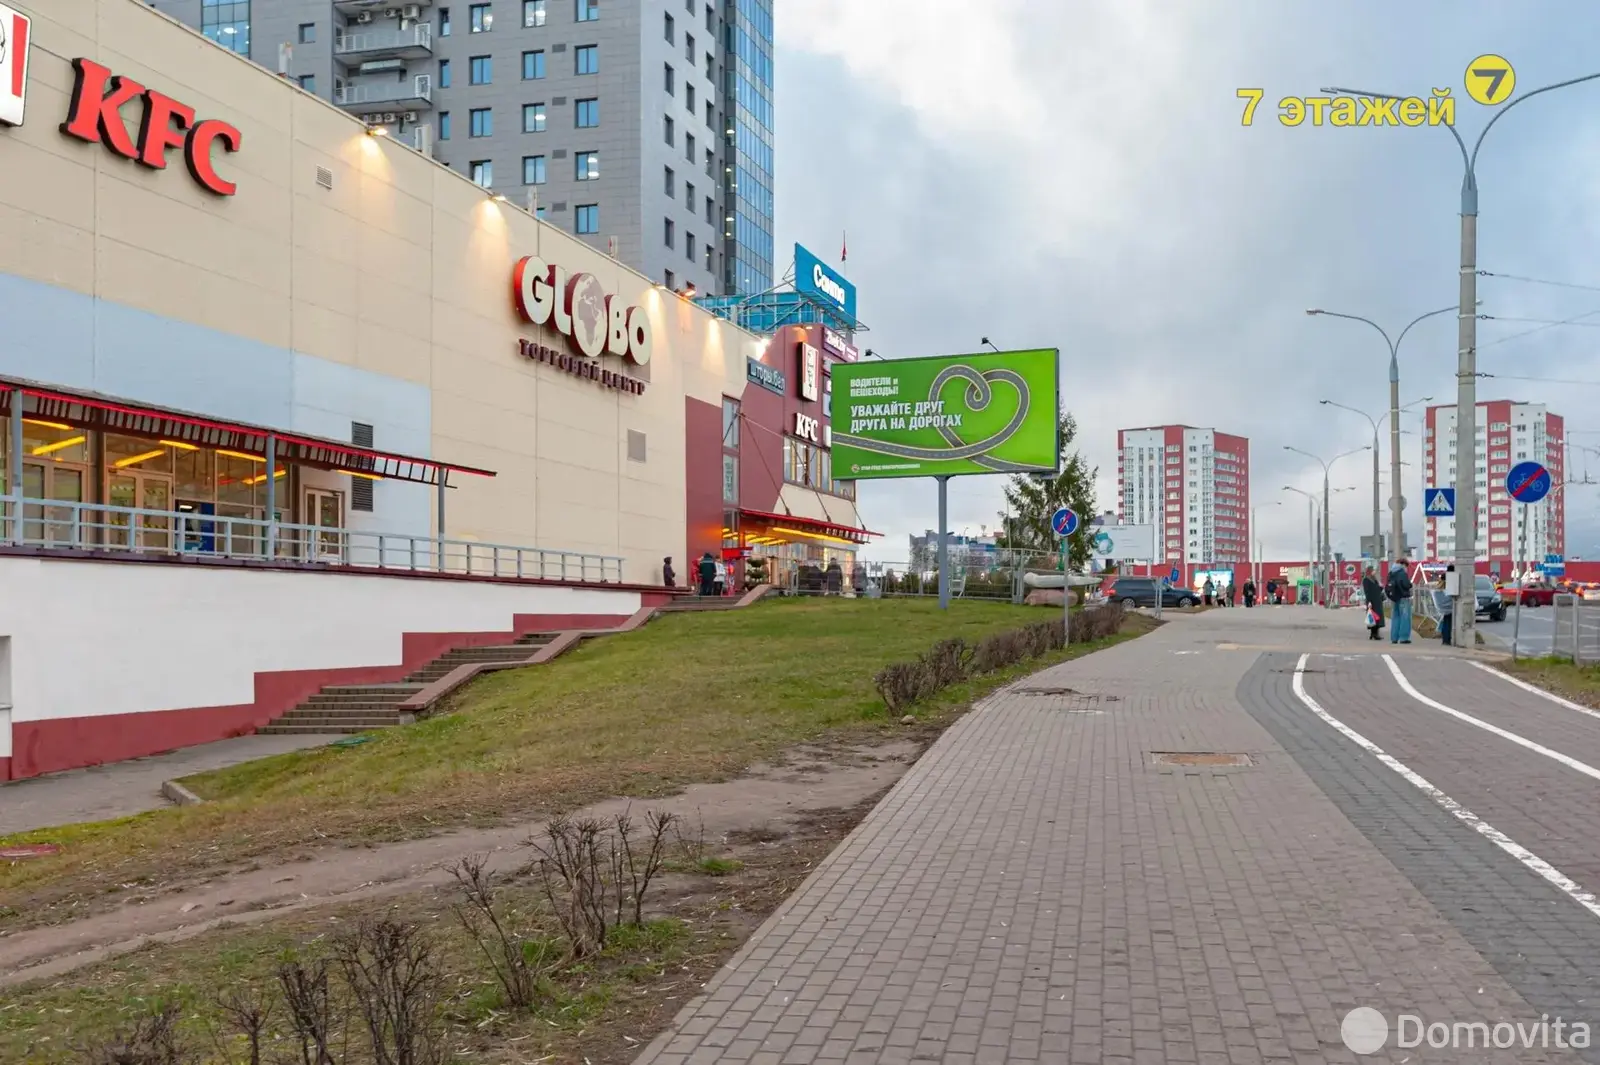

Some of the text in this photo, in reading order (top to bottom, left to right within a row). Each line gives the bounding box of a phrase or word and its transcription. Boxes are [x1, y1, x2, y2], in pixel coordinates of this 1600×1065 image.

[59, 57, 242, 196] KFC
[514, 255, 652, 366] GLOBO
[519, 338, 645, 396] ТОРГОВЫЙ ЦЕНТР
[850, 377, 891, 388] ВОДИТЕЛИ
[850, 414, 962, 433] ДРУГА НА ДОРОГАХ
[851, 401, 945, 417] УВАЖАЙТЕ ДРУГ
[794, 412, 818, 442] KFC
